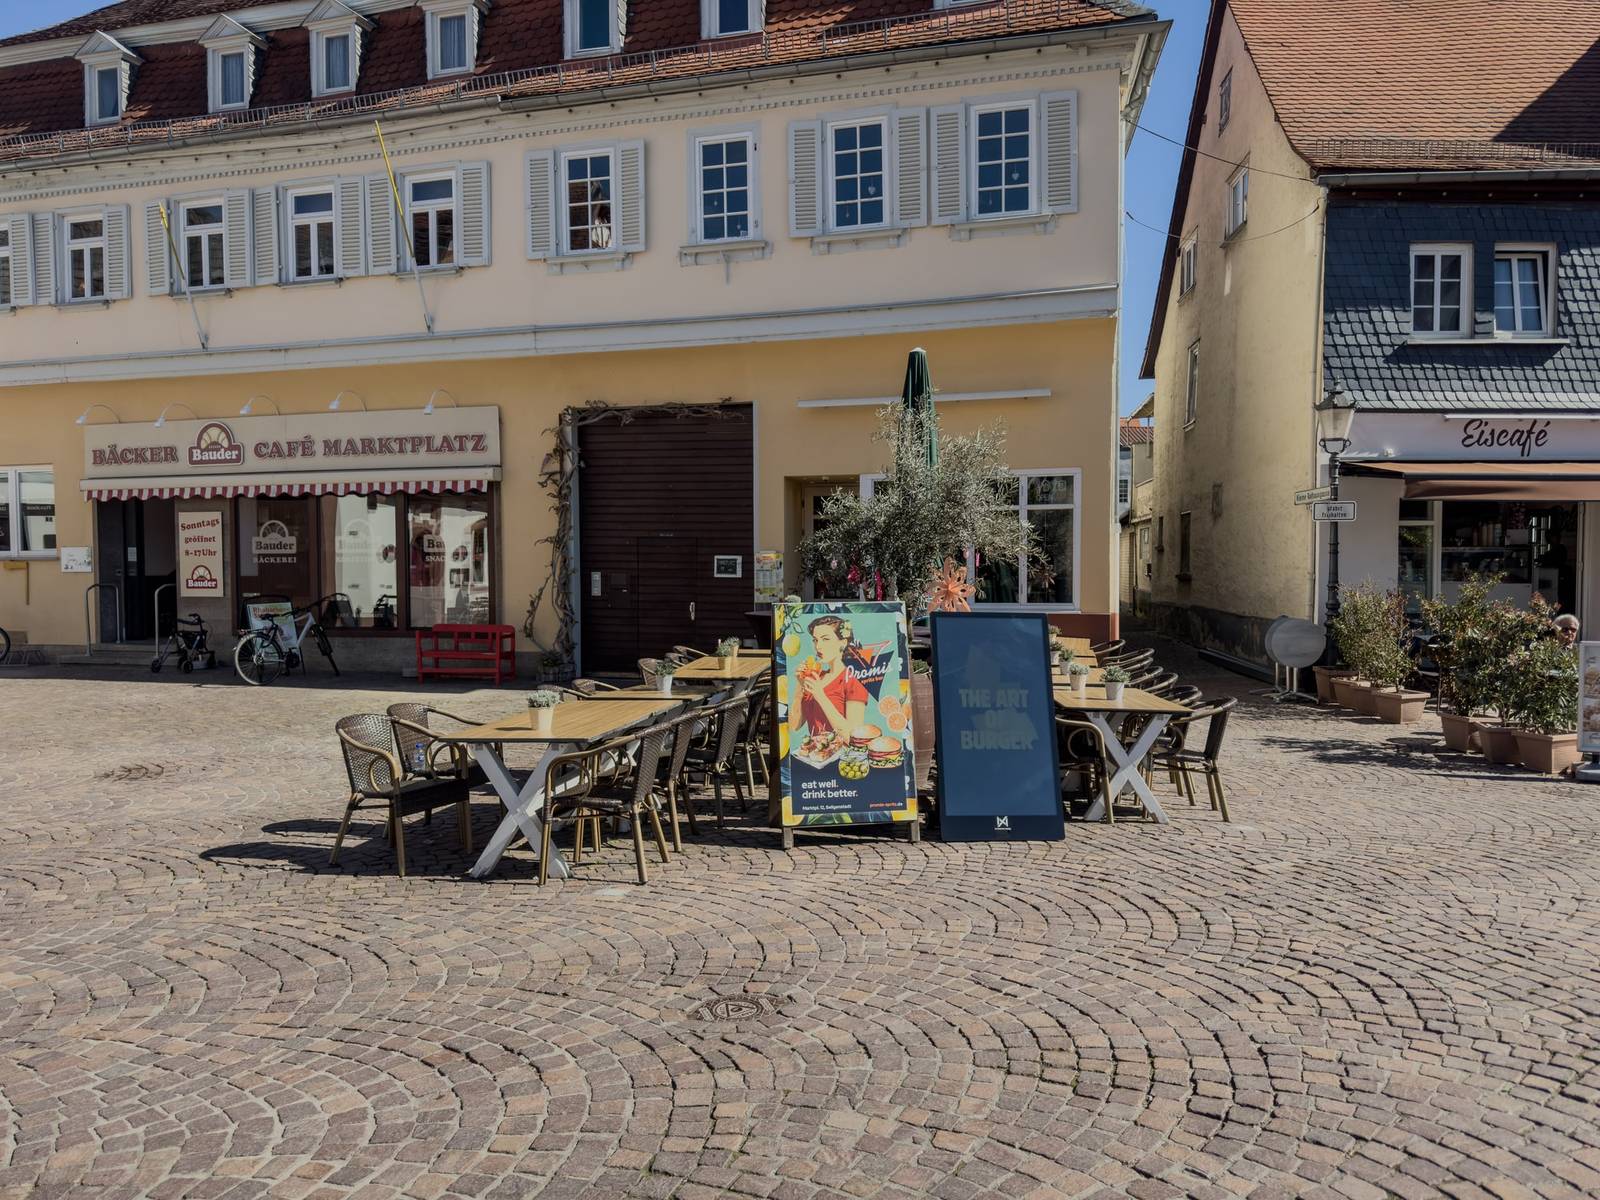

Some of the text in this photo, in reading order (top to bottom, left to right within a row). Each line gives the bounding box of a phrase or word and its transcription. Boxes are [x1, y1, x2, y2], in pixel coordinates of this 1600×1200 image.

[1461, 418, 1551, 457] Eiscafé
[254, 433, 488, 458] CAFÉ MARKTPLATZ
[92, 444, 179, 465] BÄCKER
[192, 447, 238, 461] Bauder
[180, 518, 220, 532] Sonntags
[184, 535, 216, 544] geöffnet
[255, 541, 294, 551] Bauder
[187, 579, 217, 588] Bauder
[959, 688, 1029, 708] THE ART
[960, 729, 1034, 750] BURGER
[802, 779, 839, 789] eat well.
[802, 788, 858, 799] drink better.
